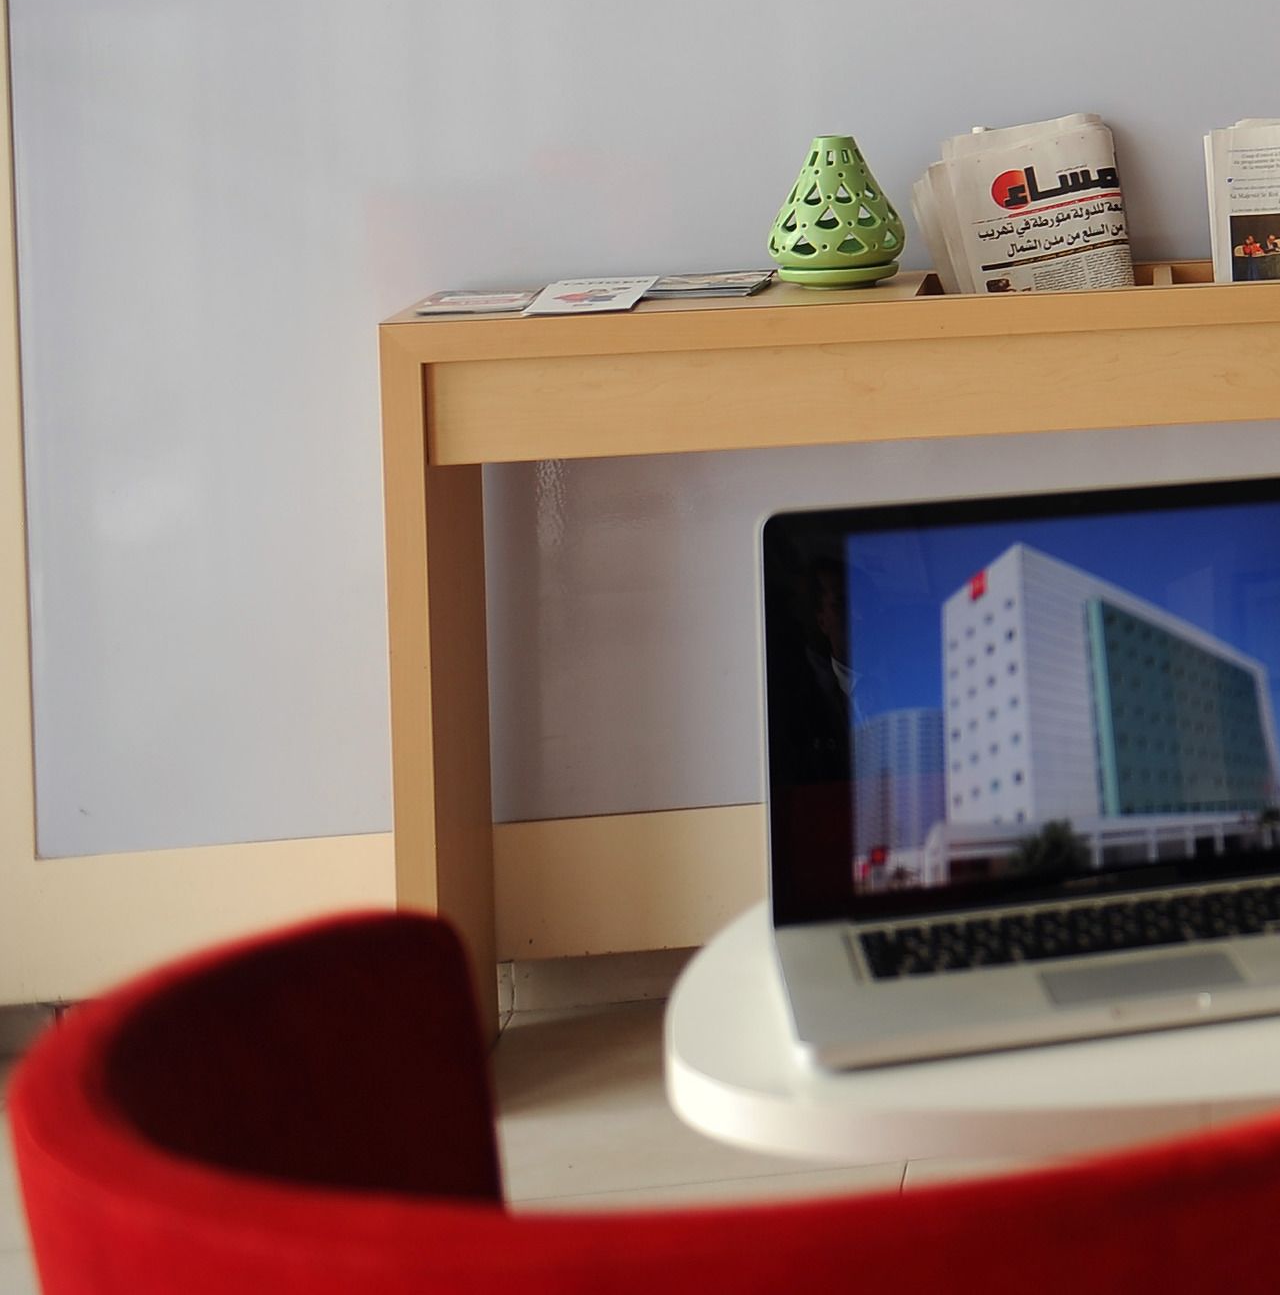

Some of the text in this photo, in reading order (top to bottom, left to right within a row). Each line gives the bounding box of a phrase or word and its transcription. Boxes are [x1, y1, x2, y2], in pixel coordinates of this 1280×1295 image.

[1032, 212, 1072, 229] متورطة
[1073, 203, 1105, 221] للدولة
[978, 222, 1014, 242] تهريب
[1016, 219, 1031, 238] في
[1082, 223, 1110, 243] السلع
[1067, 231, 1081, 246] من
[1007, 239, 1042, 257] الشمال
